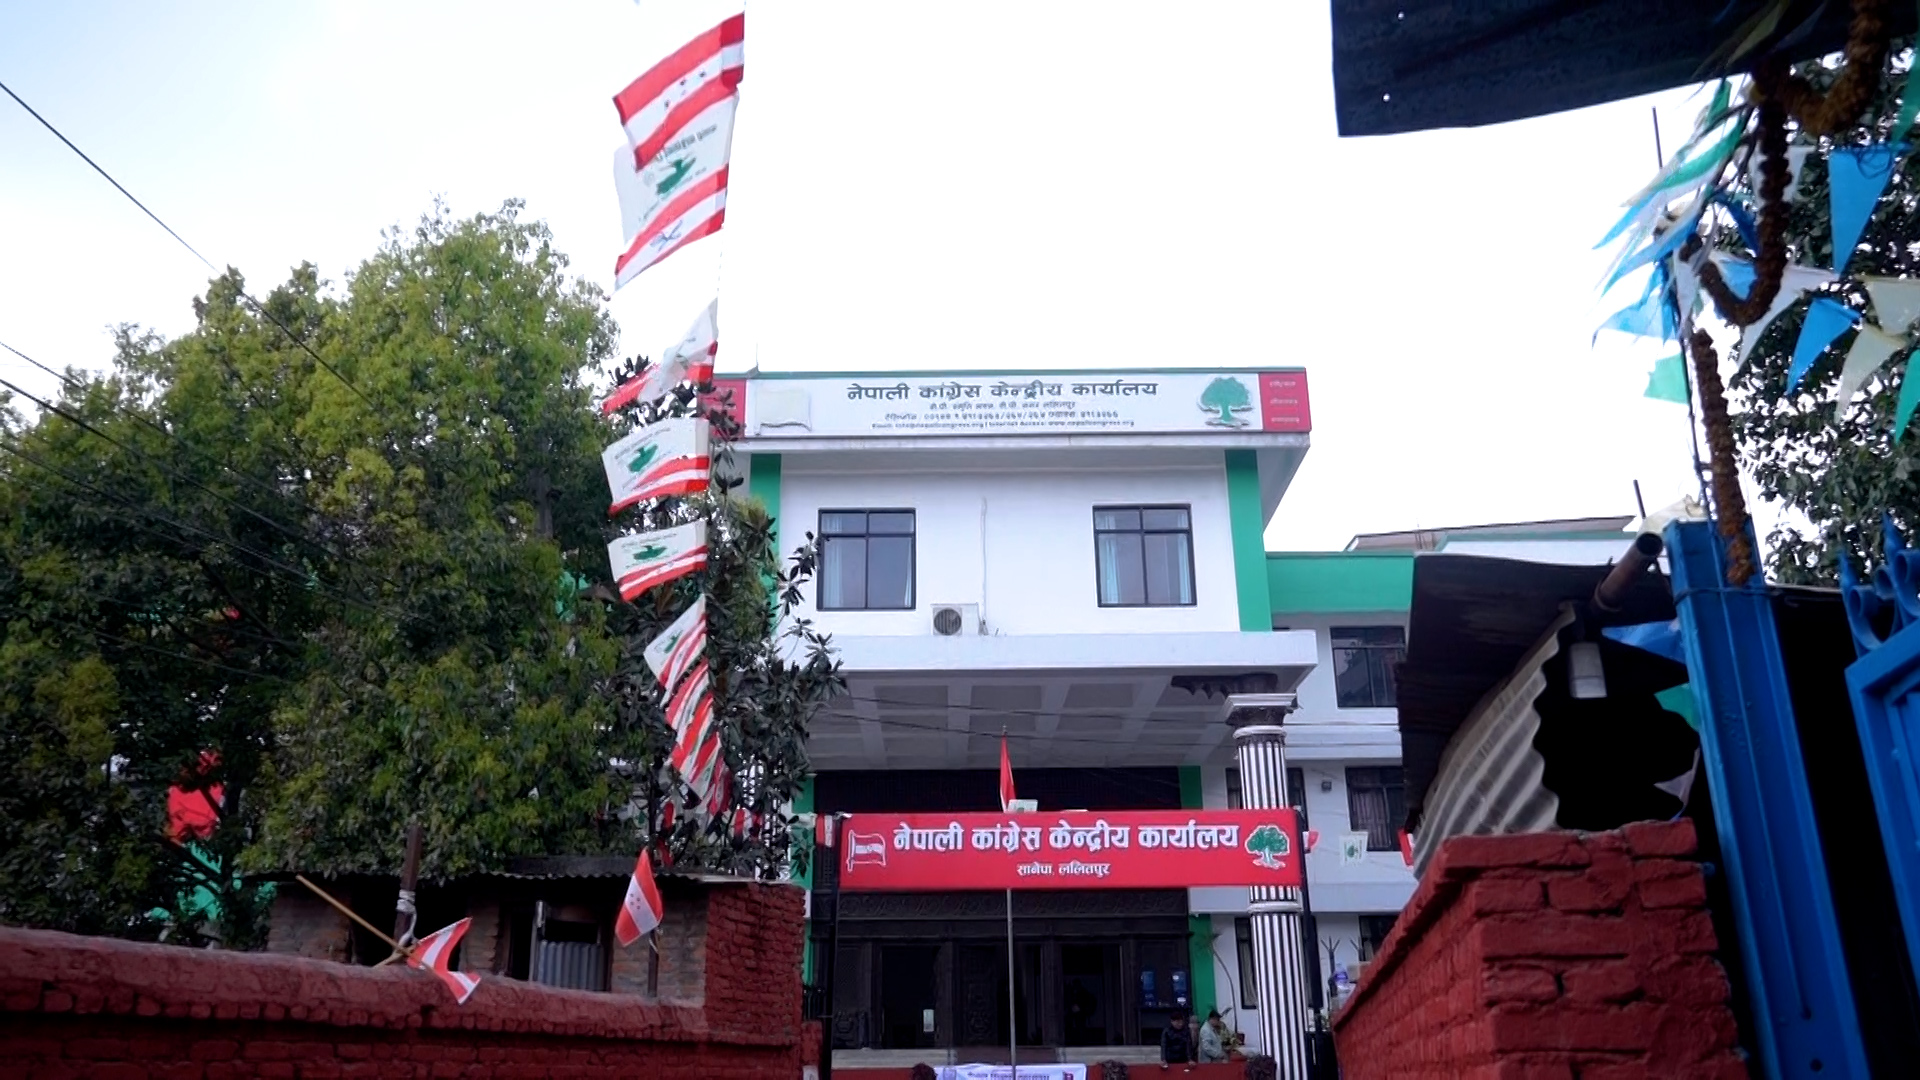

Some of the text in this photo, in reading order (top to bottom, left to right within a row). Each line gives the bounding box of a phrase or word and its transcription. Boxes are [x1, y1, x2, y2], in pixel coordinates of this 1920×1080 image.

[847, 379, 1159, 401] नेपाली कांग्रेस केन्द्रीय कार्यालय
[893, 819, 1240, 853] नेपाली कांग्रेस केन्द्रीय कार्यालय
[1058, 860, 1111, 878] ललितपुर
